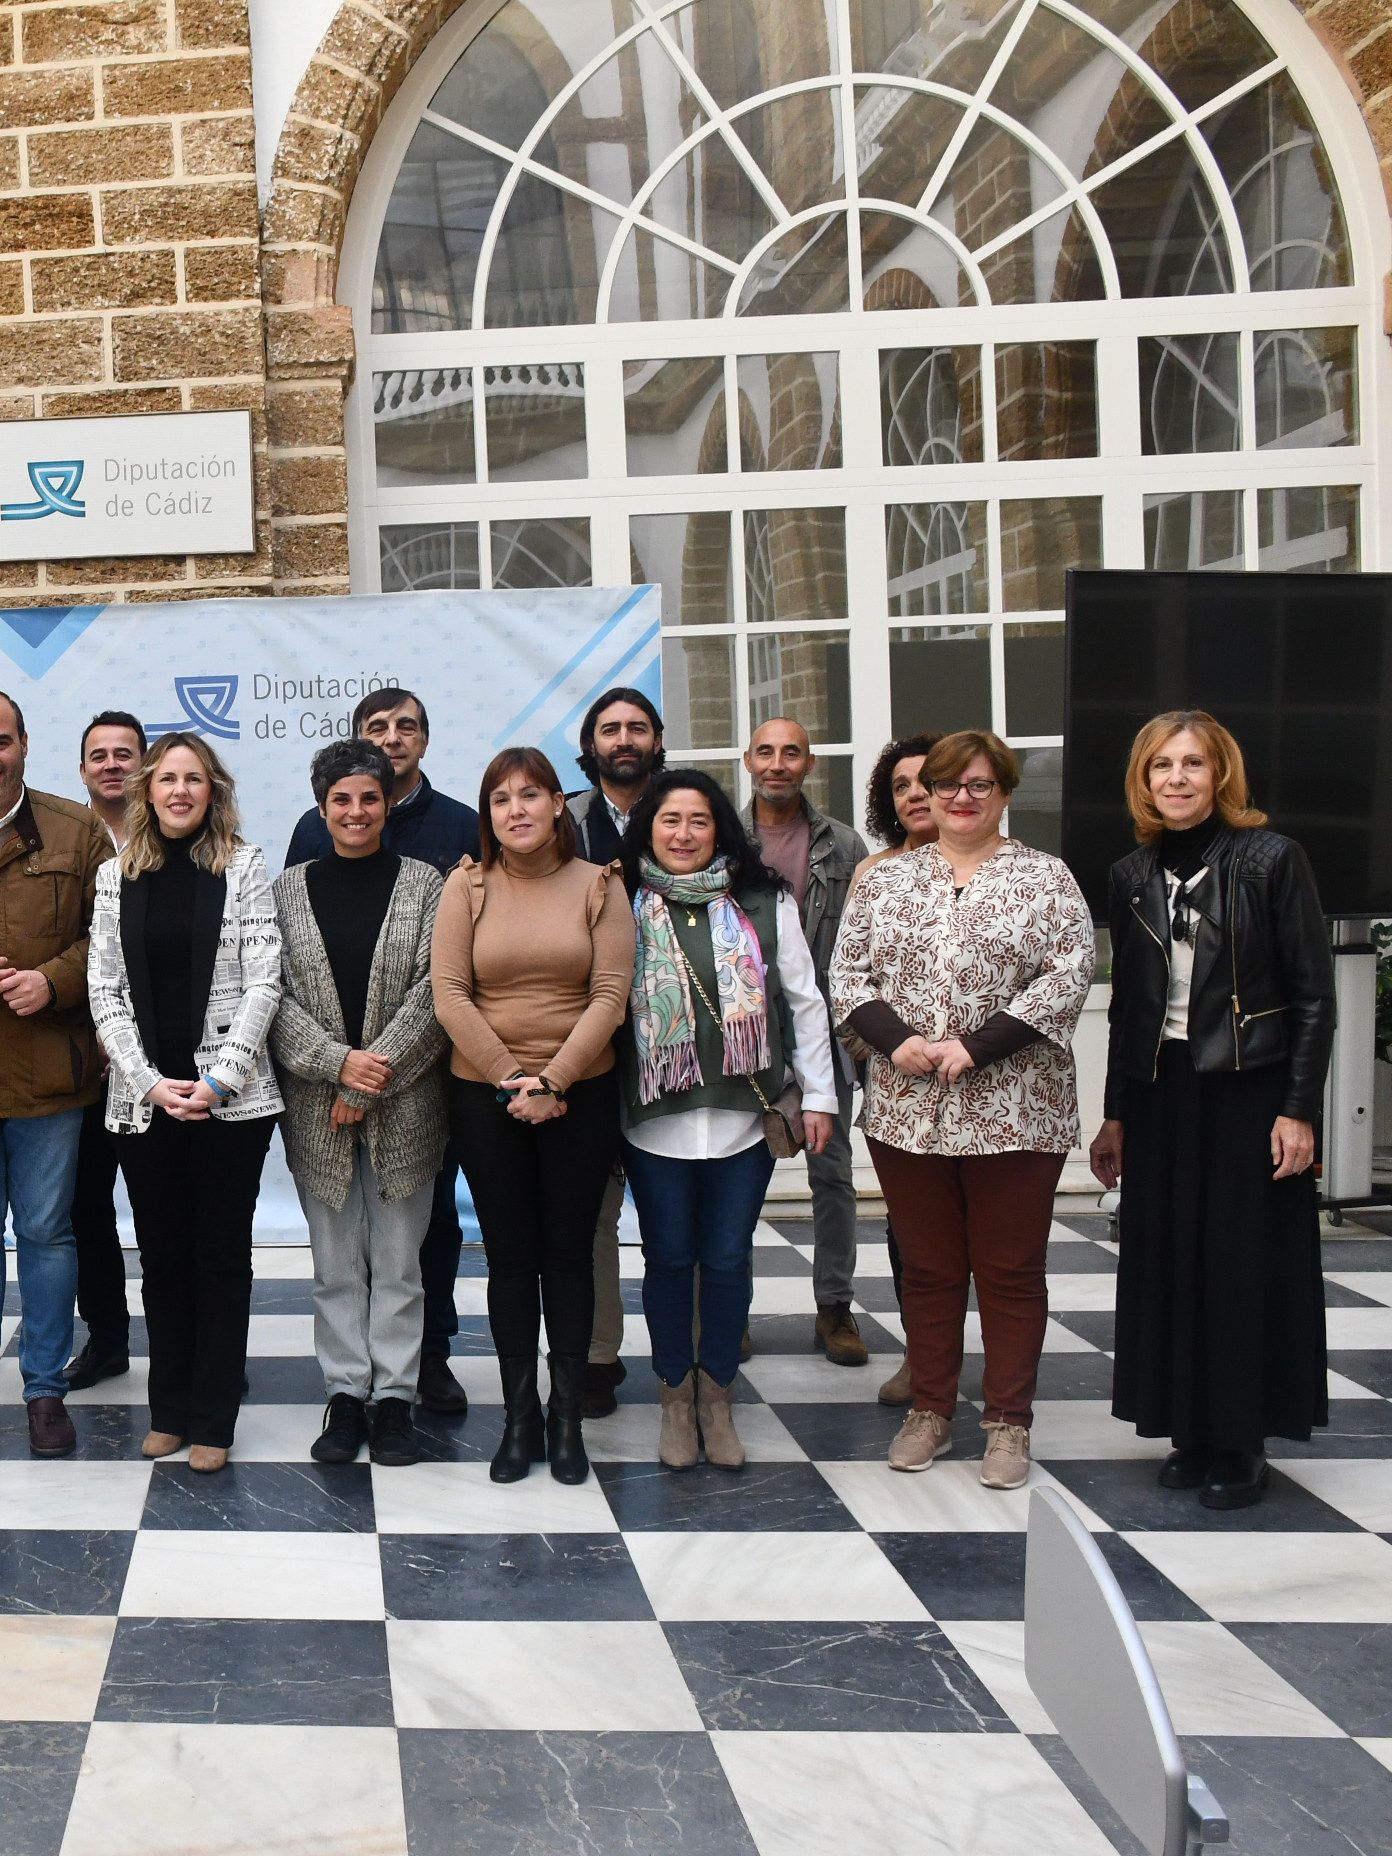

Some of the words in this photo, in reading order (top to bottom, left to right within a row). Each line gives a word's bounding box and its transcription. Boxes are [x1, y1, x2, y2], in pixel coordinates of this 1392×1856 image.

[104, 455, 236, 485] Diputación
[105, 494, 134, 517] de
[145, 490, 213, 516] Cádiz
[253, 671, 400, 704] Diputación
[254, 713, 287, 739] de
[299, 712, 351, 738] Cád
[251, 1103, 278, 1115] NEWS
